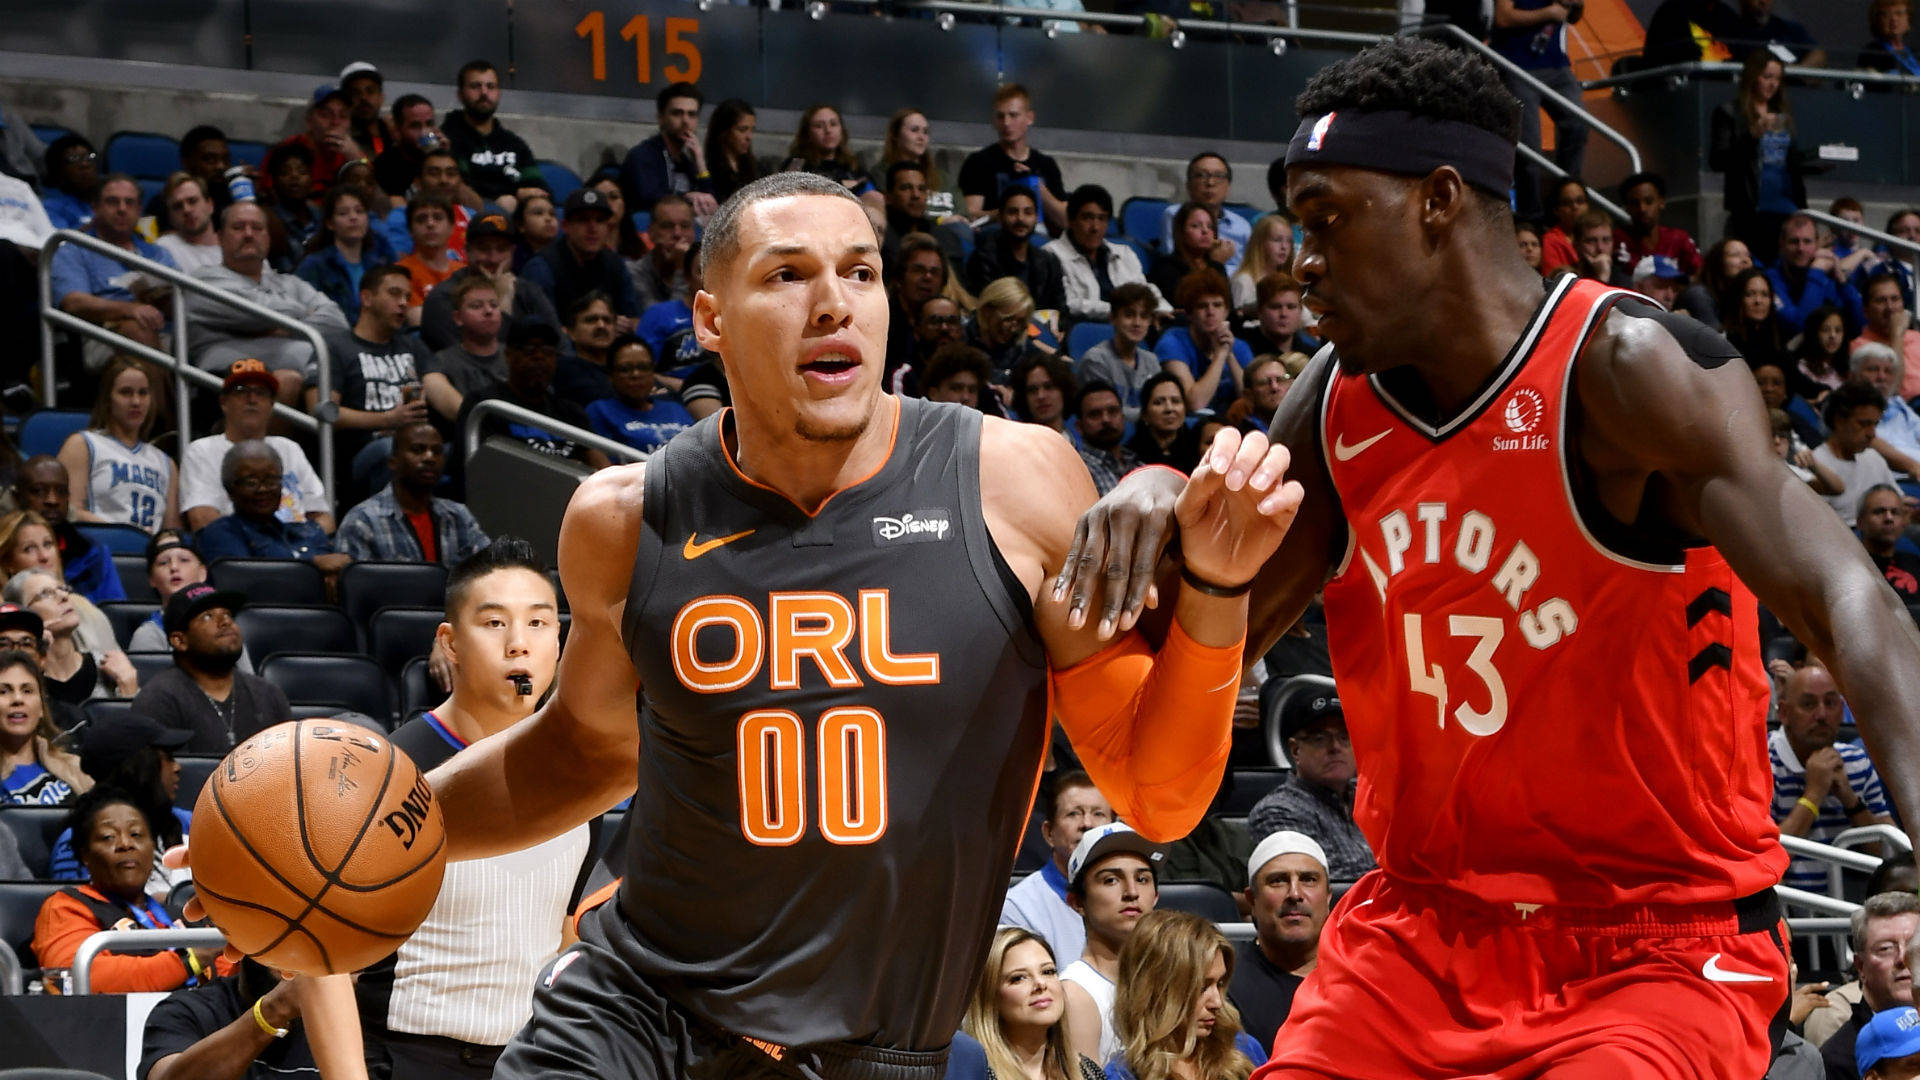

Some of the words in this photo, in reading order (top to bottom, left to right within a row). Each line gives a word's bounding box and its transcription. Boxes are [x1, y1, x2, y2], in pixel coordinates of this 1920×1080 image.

[576, 10, 702, 85] 115
[1493, 436, 1519, 451] Sun
[1522, 434, 1550, 450] Life
[131, 491, 155, 526] 12
[670, 588, 940, 694] ORL
[1404, 613, 1508, 737] 43
[737, 706, 888, 846] 00
